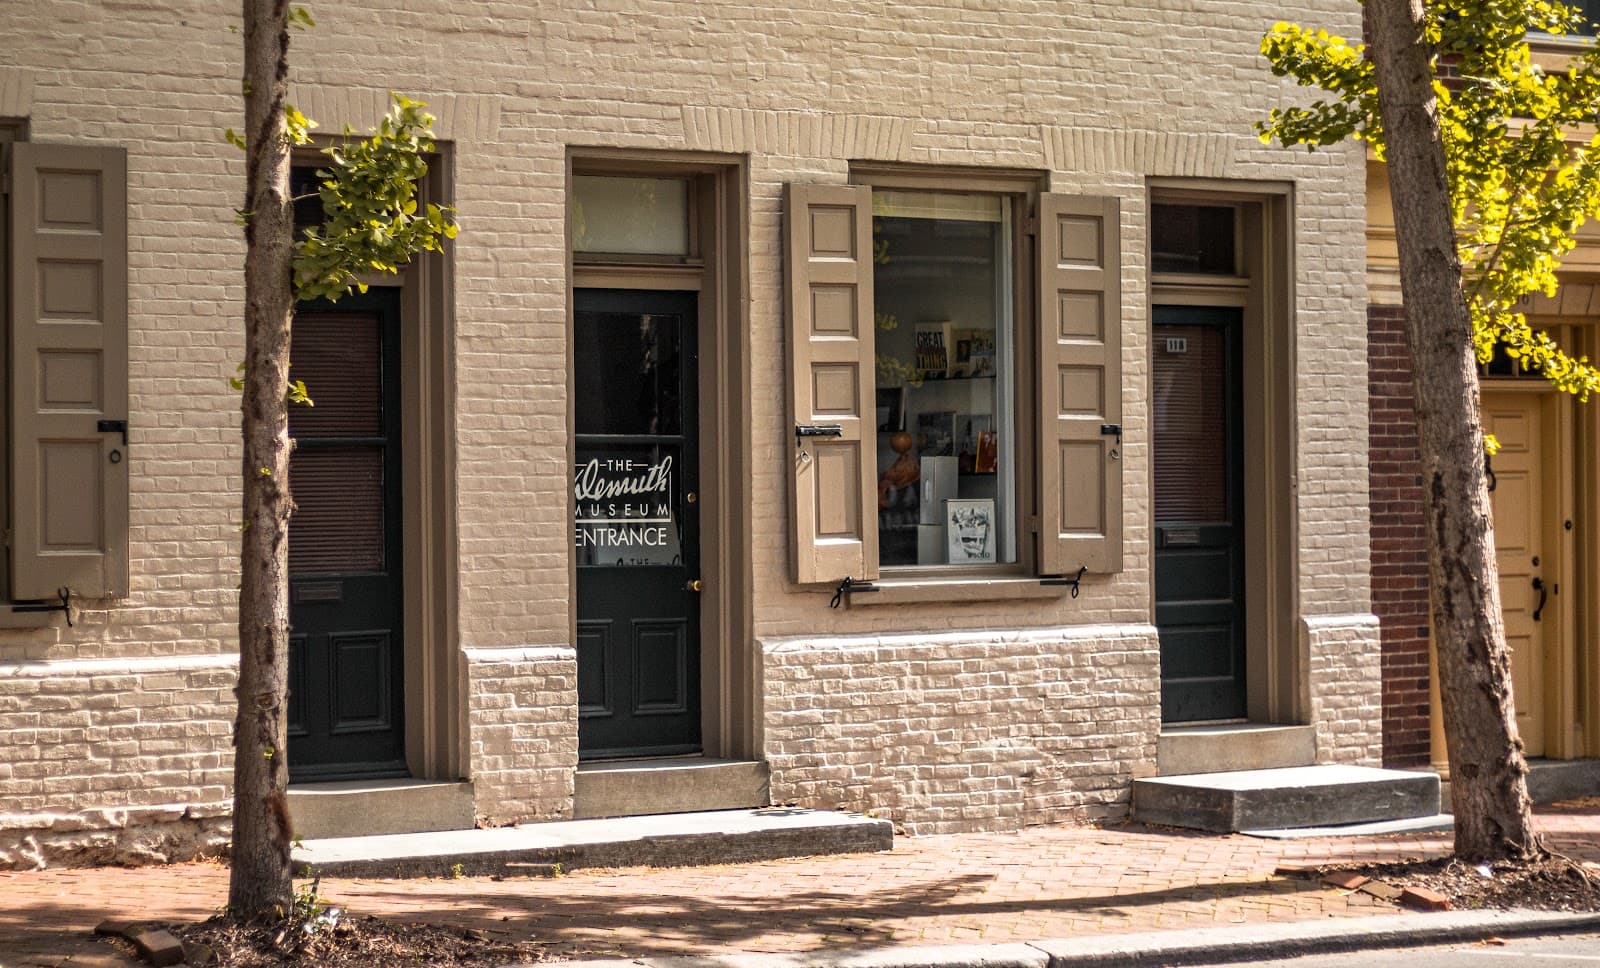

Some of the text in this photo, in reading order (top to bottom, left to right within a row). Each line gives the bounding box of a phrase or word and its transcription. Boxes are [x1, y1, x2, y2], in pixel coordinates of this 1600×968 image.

[917, 331, 943, 348] GREAT
[607, 460, 632, 471] THE
[576, 528, 667, 546] ENTRANCE
